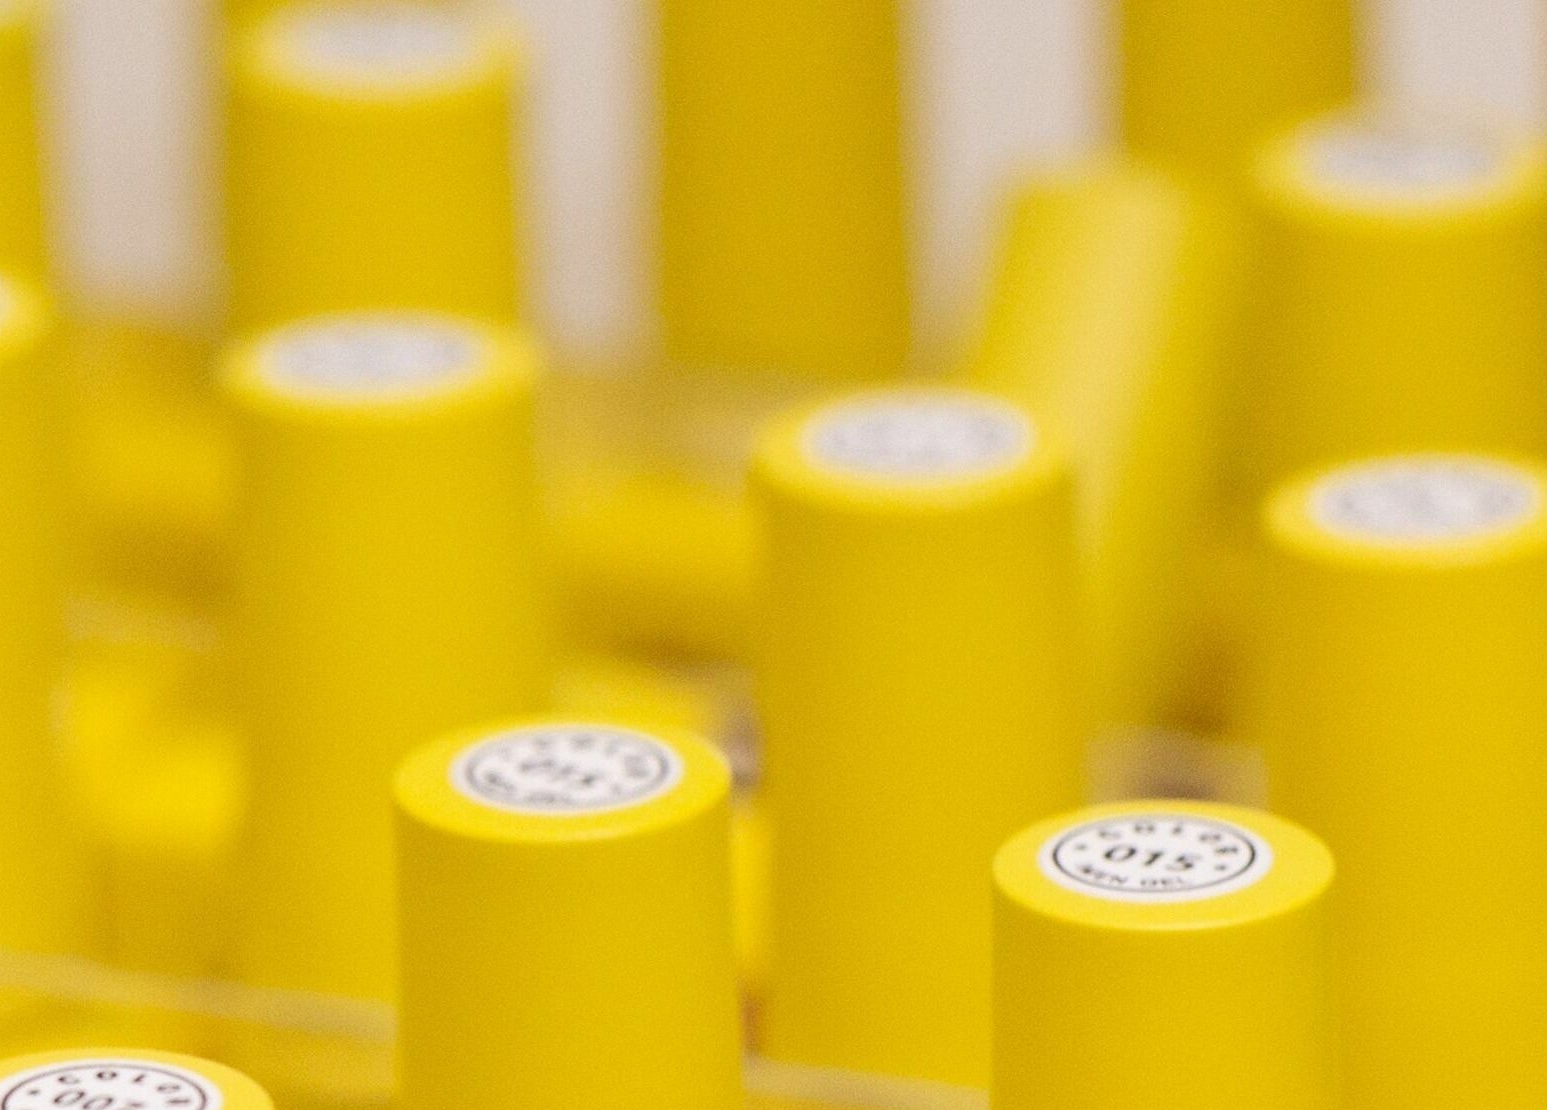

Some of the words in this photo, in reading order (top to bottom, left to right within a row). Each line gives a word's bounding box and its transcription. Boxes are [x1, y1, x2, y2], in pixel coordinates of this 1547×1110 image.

[1098, 821, 1238, 855] COLOR
[1104, 845, 1202, 872] 015
[57, 1069, 192, 1105] COLOR
